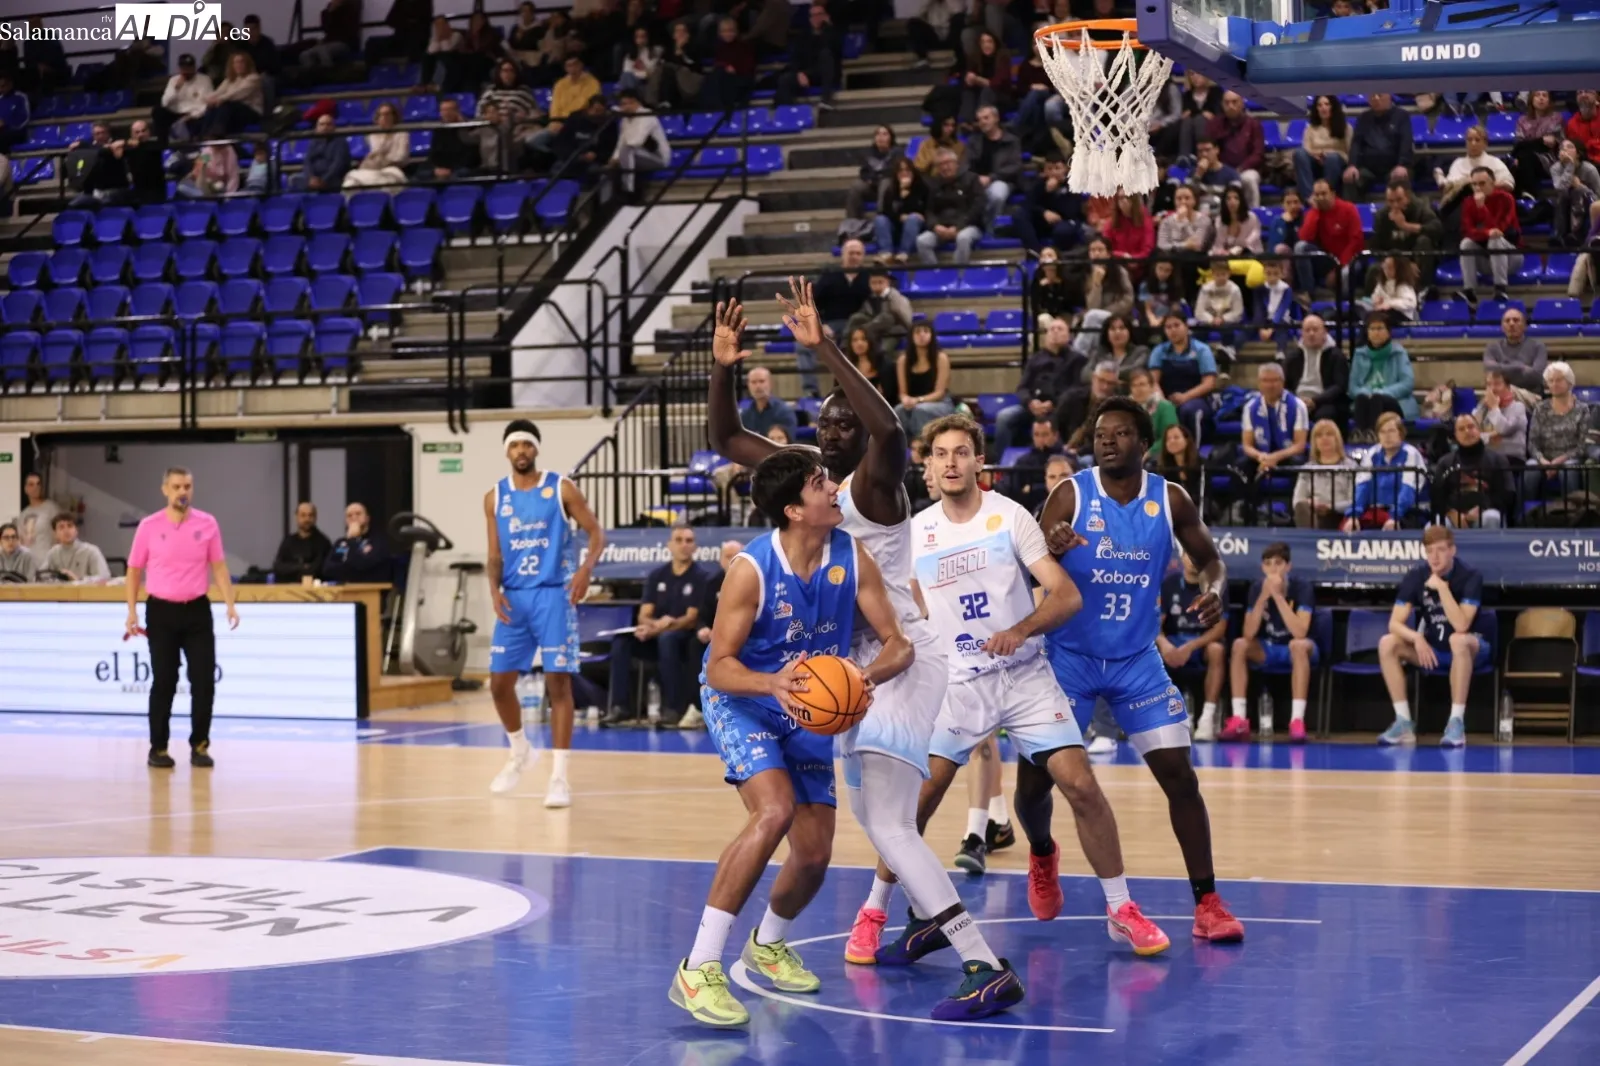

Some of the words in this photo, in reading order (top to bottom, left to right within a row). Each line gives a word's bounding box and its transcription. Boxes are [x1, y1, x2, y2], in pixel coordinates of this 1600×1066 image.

[1401, 42, 1481, 62] MONDO
[1528, 539, 1600, 557] CASTIL
[518, 555, 539, 576] 22
[1090, 568, 1150, 588] Xoborg
[959, 591, 991, 621] 32
[1100, 592, 1132, 621] 33
[956, 639, 986, 652] SOLG
[95, 652, 121, 682] el
[946, 916, 972, 936] BOSS
